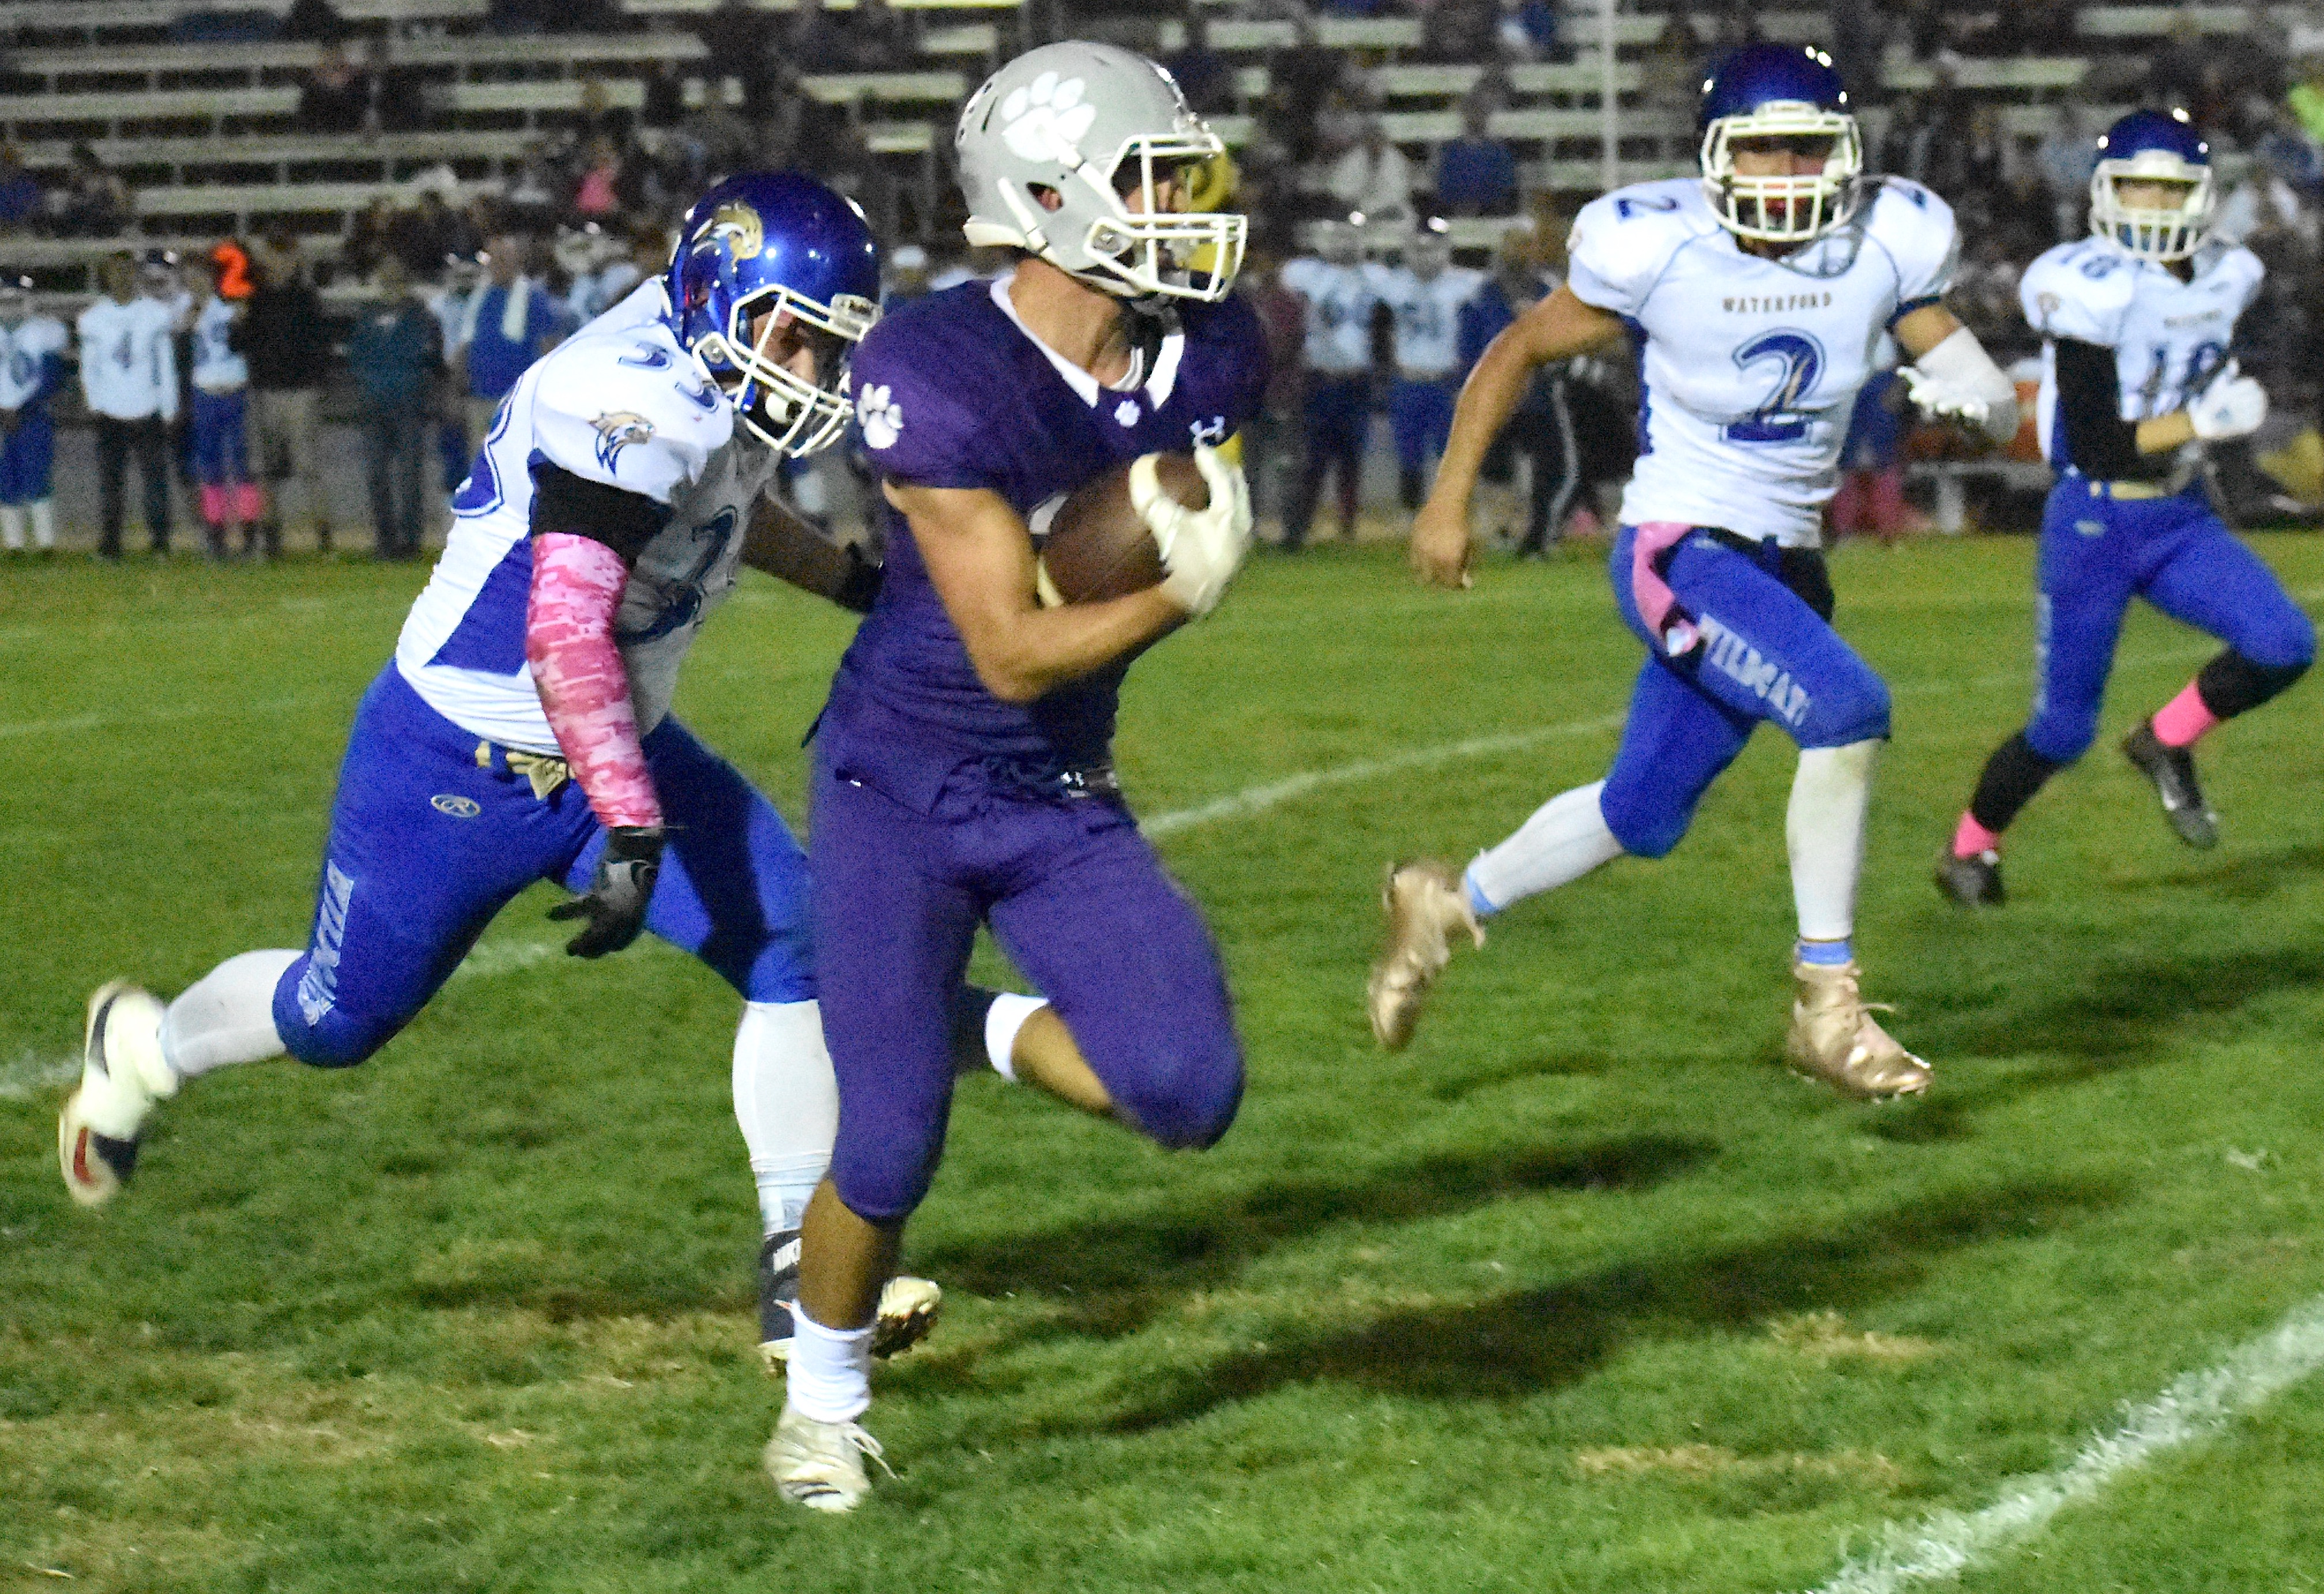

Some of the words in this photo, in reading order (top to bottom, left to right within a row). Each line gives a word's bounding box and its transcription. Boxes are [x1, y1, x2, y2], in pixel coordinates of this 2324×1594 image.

[211, 239, 255, 299] 2
[1722, 291, 1833, 314] WATERFORD
[1717, 326, 1828, 444] 2
